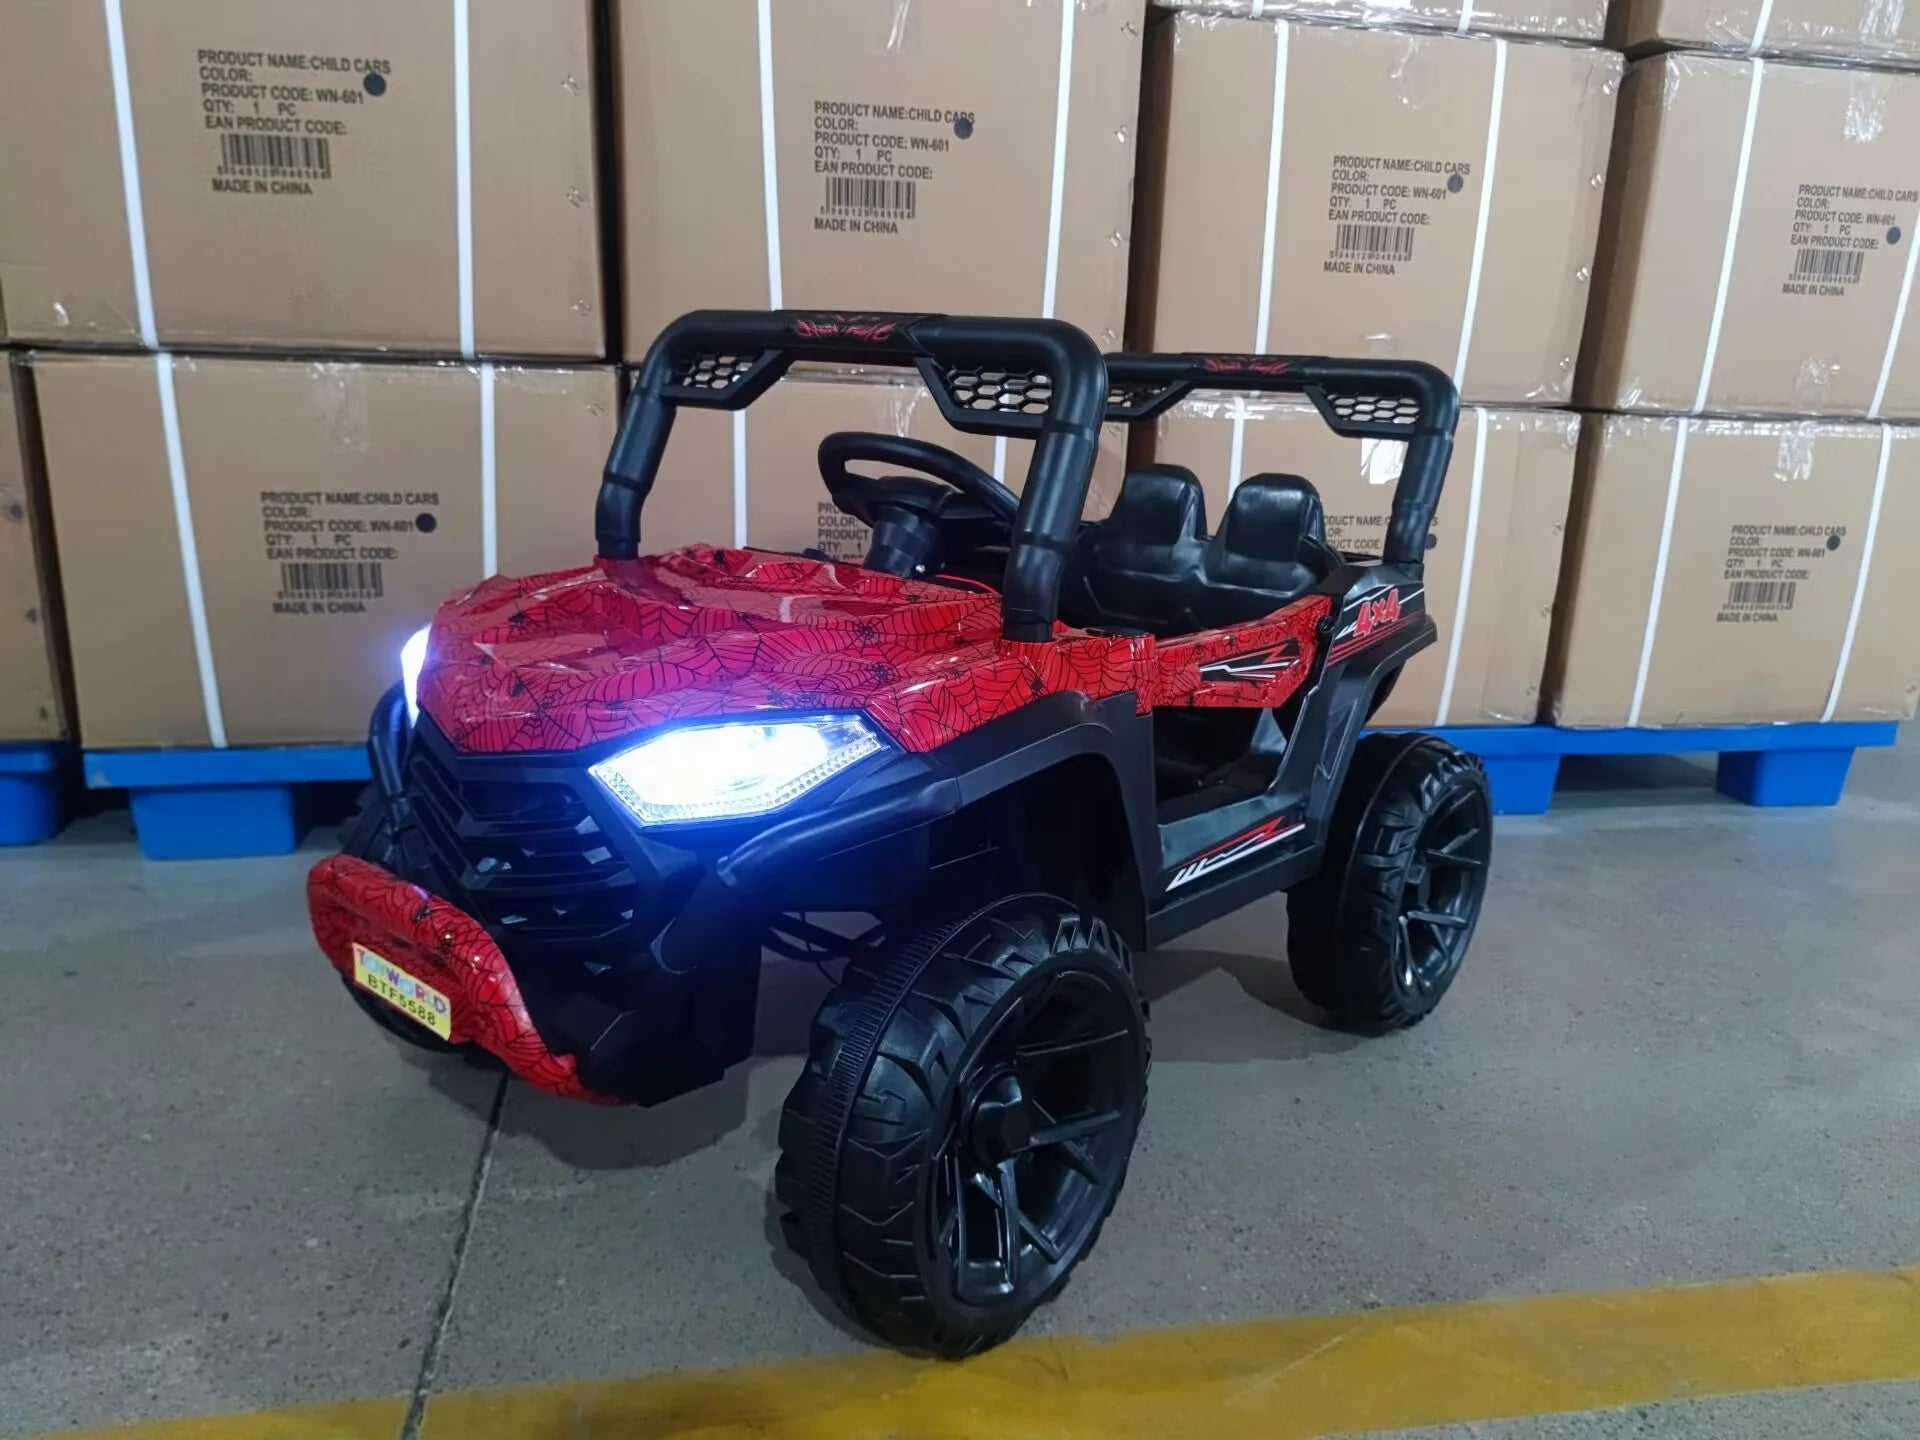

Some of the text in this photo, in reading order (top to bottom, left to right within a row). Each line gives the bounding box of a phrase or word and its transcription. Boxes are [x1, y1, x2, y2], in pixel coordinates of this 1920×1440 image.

[198, 49, 264, 66] PRODUCT
[354, 59, 391, 74] CARS
[199, 67, 252, 81] COLOR:
[202, 83, 363, 104] PRODUCT CODE: WN-601
[203, 100, 296, 115] QTY: 1 PC
[815, 101, 870, 116] PRODUCT
[205, 115, 347, 135] EAN PRODUCT CODE:
[815, 117, 858, 131] COLOR:
[815, 131, 949, 152] PRODUCT CODE: WN-601
[815, 146, 892, 162] QTY: 1 PC
[815, 160, 932, 180] EAN PRODUCT CODE:
[1333, 156, 1381, 169] PRODUCT
[1444, 162, 1470, 175] CARS
[1332, 169, 1370, 181] COLOR:
[212, 178, 313, 195] MADE IN CHINA
[1331, 183, 1447, 199] PRODUCT CODE: WN-601
[1798, 184, 1841, 197] PRODUCT
[1895, 190, 1918, 202] CARS
[1329, 196, 1396, 210] QTY: 1 PC
[1796, 197, 1830, 209] COLOR:
[1329, 209, 1430, 225] EAN PRODUCT CODE:
[1795, 210, 1896, 225] PRODUCT CODE: WN-601
[814, 218, 898, 234] MADE IN CHINA
[1793, 222, 1851, 235] QTY: 1 PC
[1791, 234, 1879, 249] EAN PRODUCT CODE:
[1323, 261, 1395, 274] MADE IN CHINA
[1782, 284, 1844, 296] MADE IN CHINA
[261, 491, 322, 503] PRODUCT
[405, 493, 440, 505] CARS
[264, 520, 325, 532] PRODUCT
[328, 520, 367, 532] CODE:
[1731, 525, 1772, 536] PRODUCT
[1825, 526, 1846, 536] CARS
[335, 534, 352, 545] PC
[818, 528, 869, 540] PRODUCT
[267, 548, 293, 559] EAN
[296, 548, 355, 559] PRODUCT
[1728, 548, 1768, 558] PRODUCT
[1770, 548, 1795, 558] CODE:
[1771, 560, 1783, 568] PC
[1724, 570, 1742, 579] EAN
[1744, 570, 1784, 579] PRODUCT
[273, 602, 366, 614] MADE IN CHINA
[1716, 612, 1778, 622] MADE IN CHINA
[367, 973, 436, 1026] BTF5588
